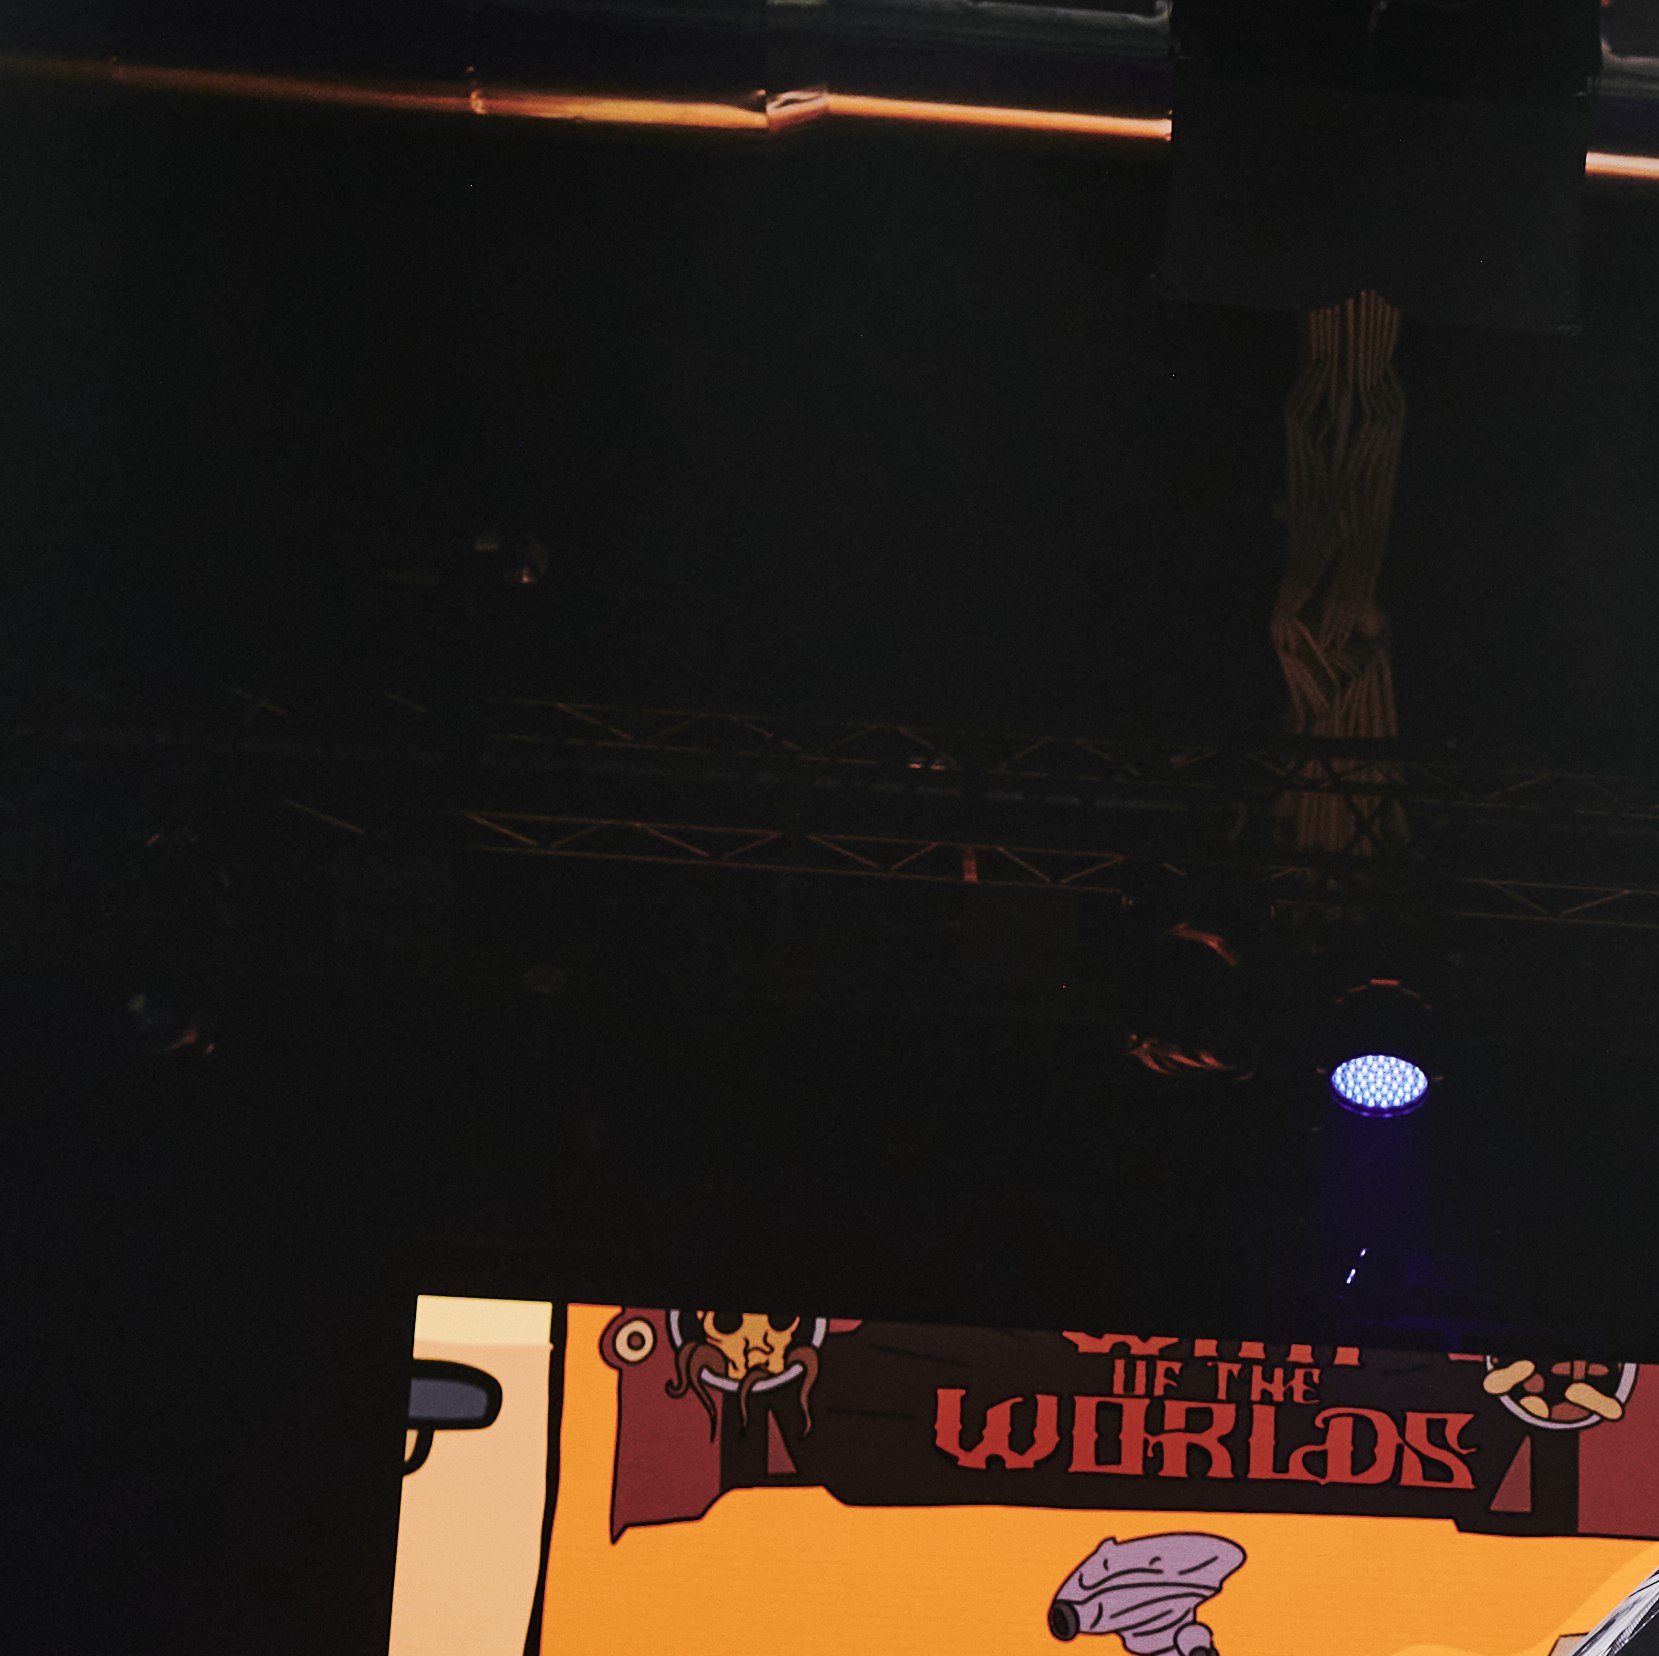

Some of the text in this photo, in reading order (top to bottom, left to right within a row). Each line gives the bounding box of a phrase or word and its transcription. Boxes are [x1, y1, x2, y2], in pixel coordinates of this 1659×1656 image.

[1112, 1358, 1321, 1404] OF THE
[934, 1388, 1476, 1489] WORLDS
